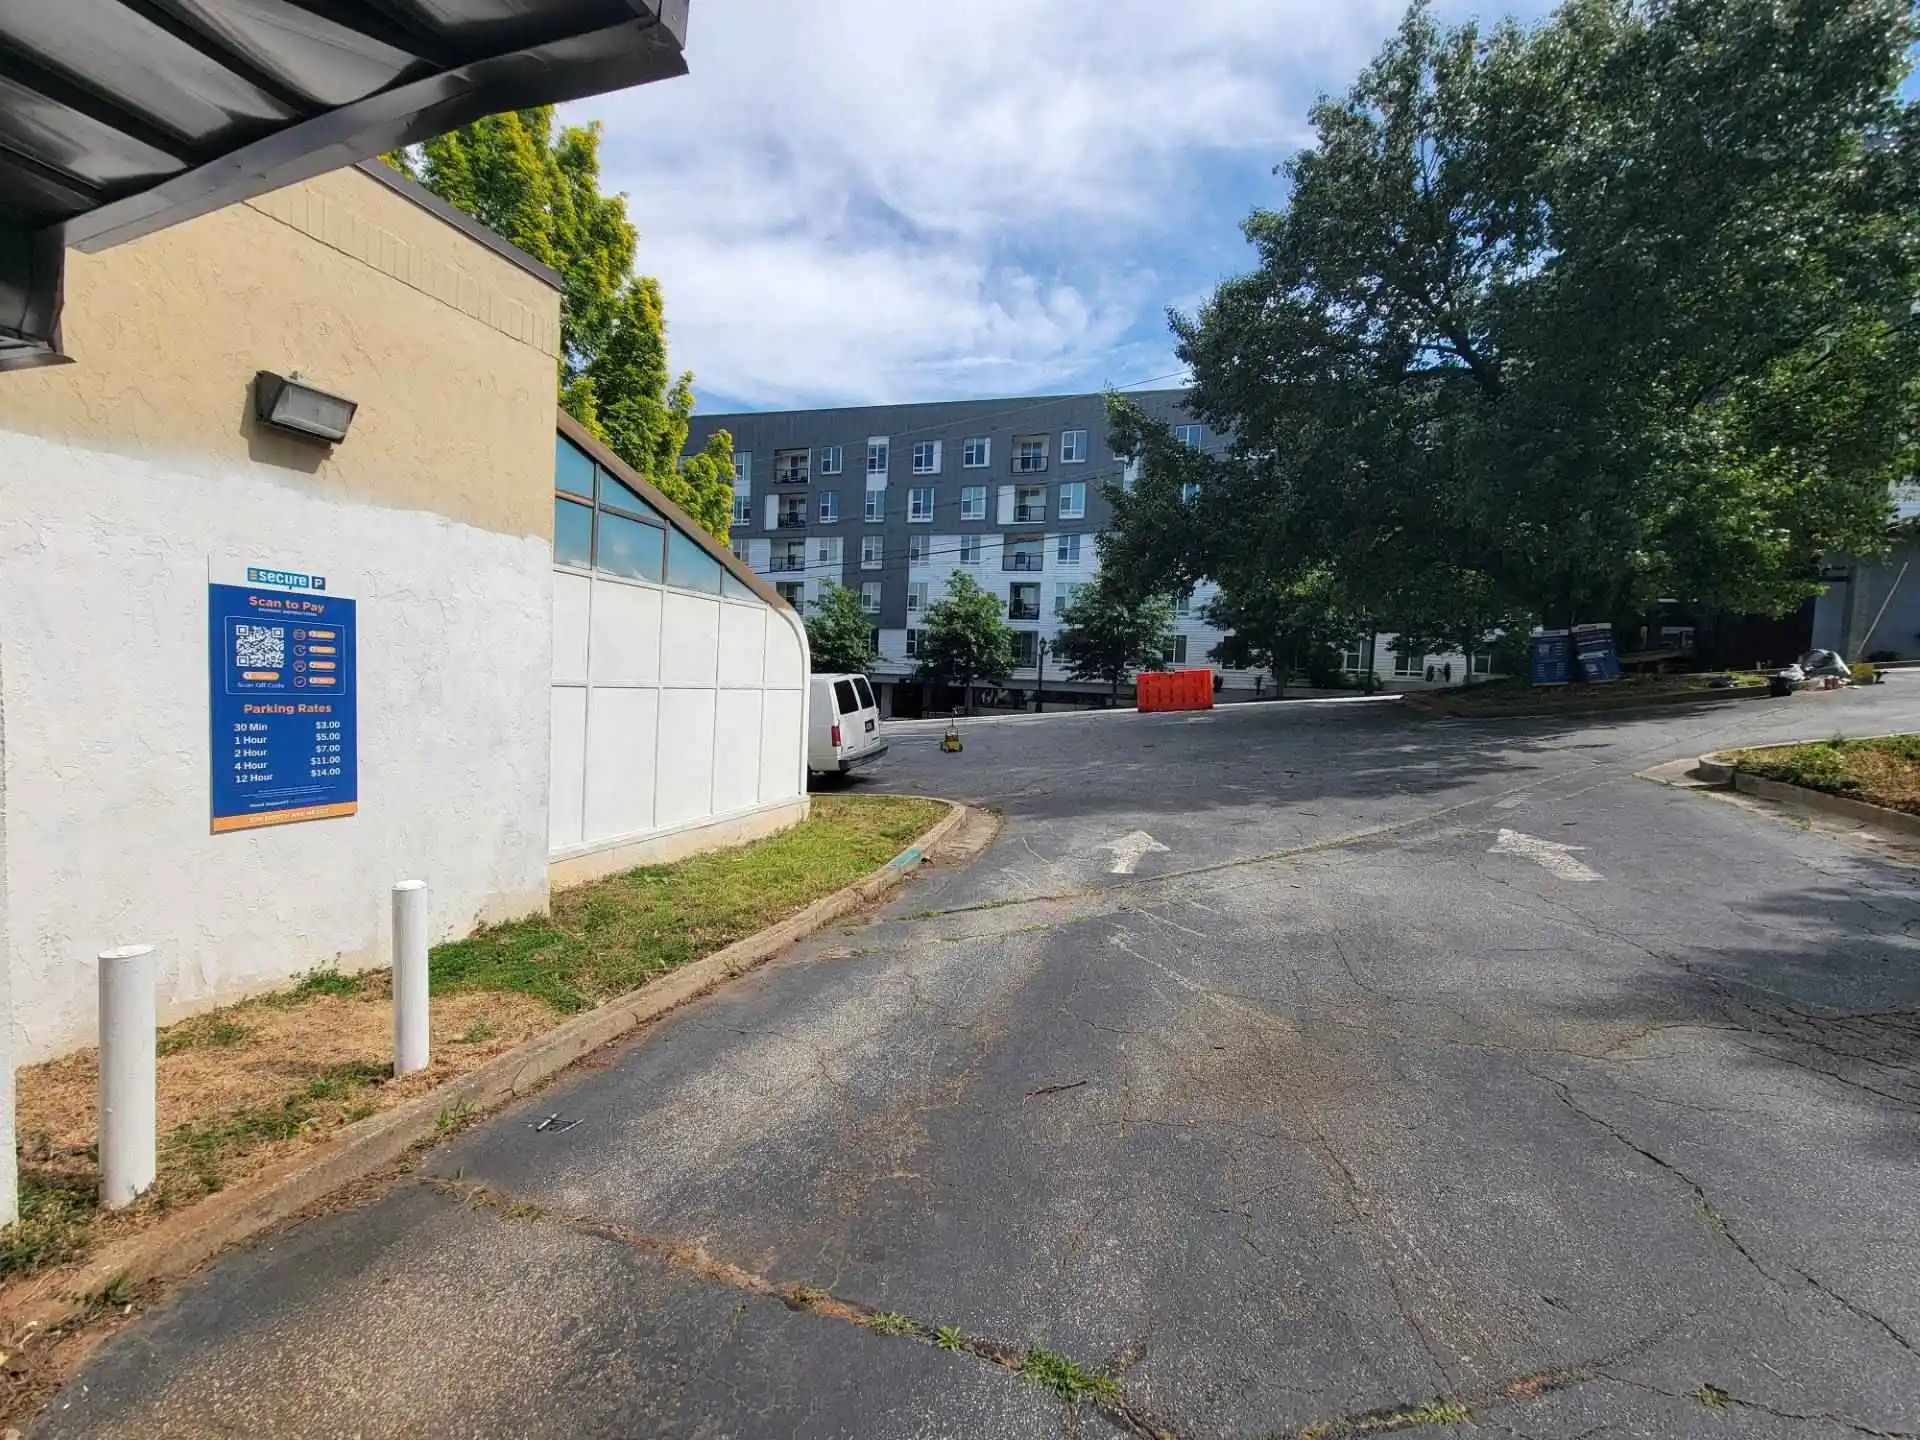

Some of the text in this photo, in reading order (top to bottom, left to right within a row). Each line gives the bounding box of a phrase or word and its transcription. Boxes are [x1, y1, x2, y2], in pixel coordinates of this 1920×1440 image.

[258, 569, 307, 586] secure
[314, 578, 323, 588] P
[248, 596, 282, 608] Scan
[285, 598, 298, 609] to
[303, 600, 325, 613] Pay
[243, 703, 332, 714] Parking Rates
[233, 721, 341, 732] 30 Min $3.00
[234, 732, 341, 744] 1 Hour $5.00
[234, 744, 341, 757] 2 Hour $7.00
[234, 756, 341, 770] 4 Hour $11.00
[235, 767, 341, 783] 12 Hour $14.00
